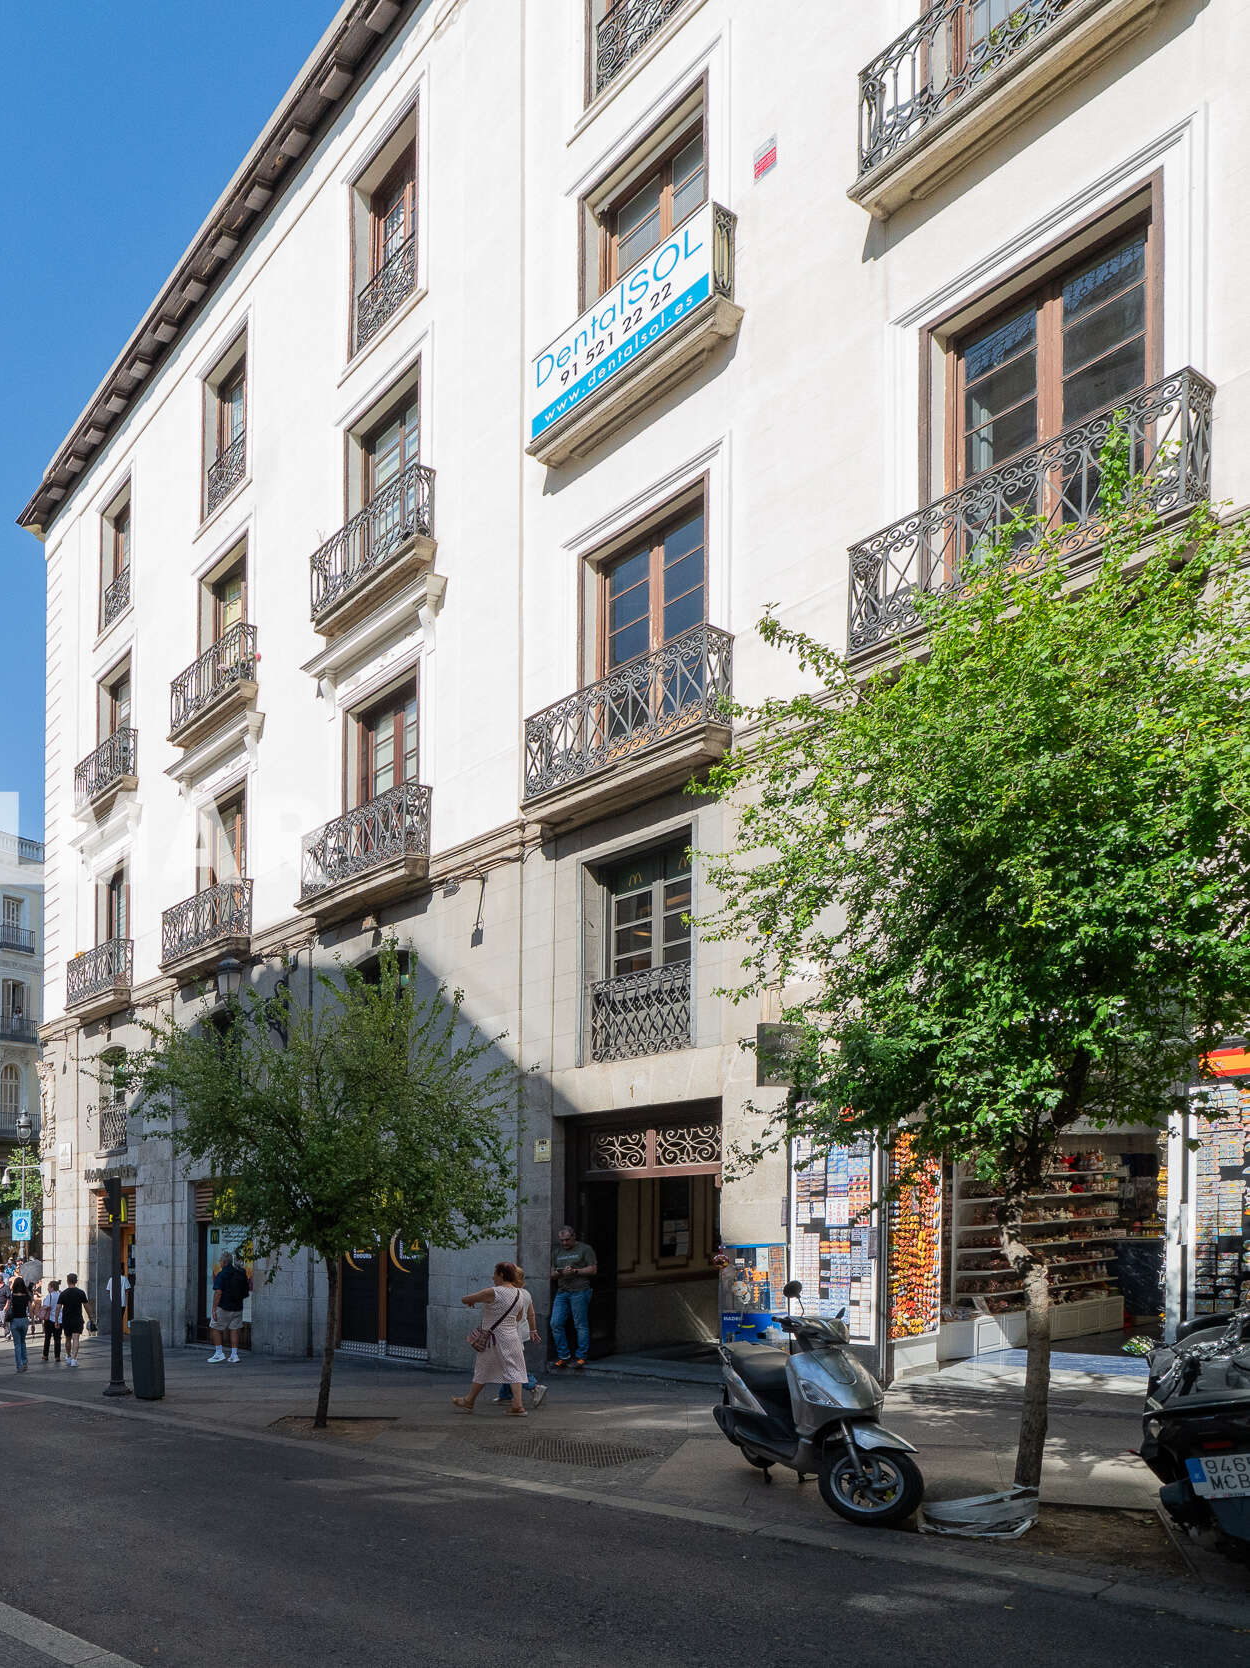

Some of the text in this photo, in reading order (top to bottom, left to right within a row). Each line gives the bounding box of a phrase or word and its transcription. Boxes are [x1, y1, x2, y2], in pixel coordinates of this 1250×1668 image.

[536, 229, 703, 389] DentalSOL
[544, 294, 694, 423] www.dentalsol.es
[560, 281, 672, 386] 91 521 22 22
